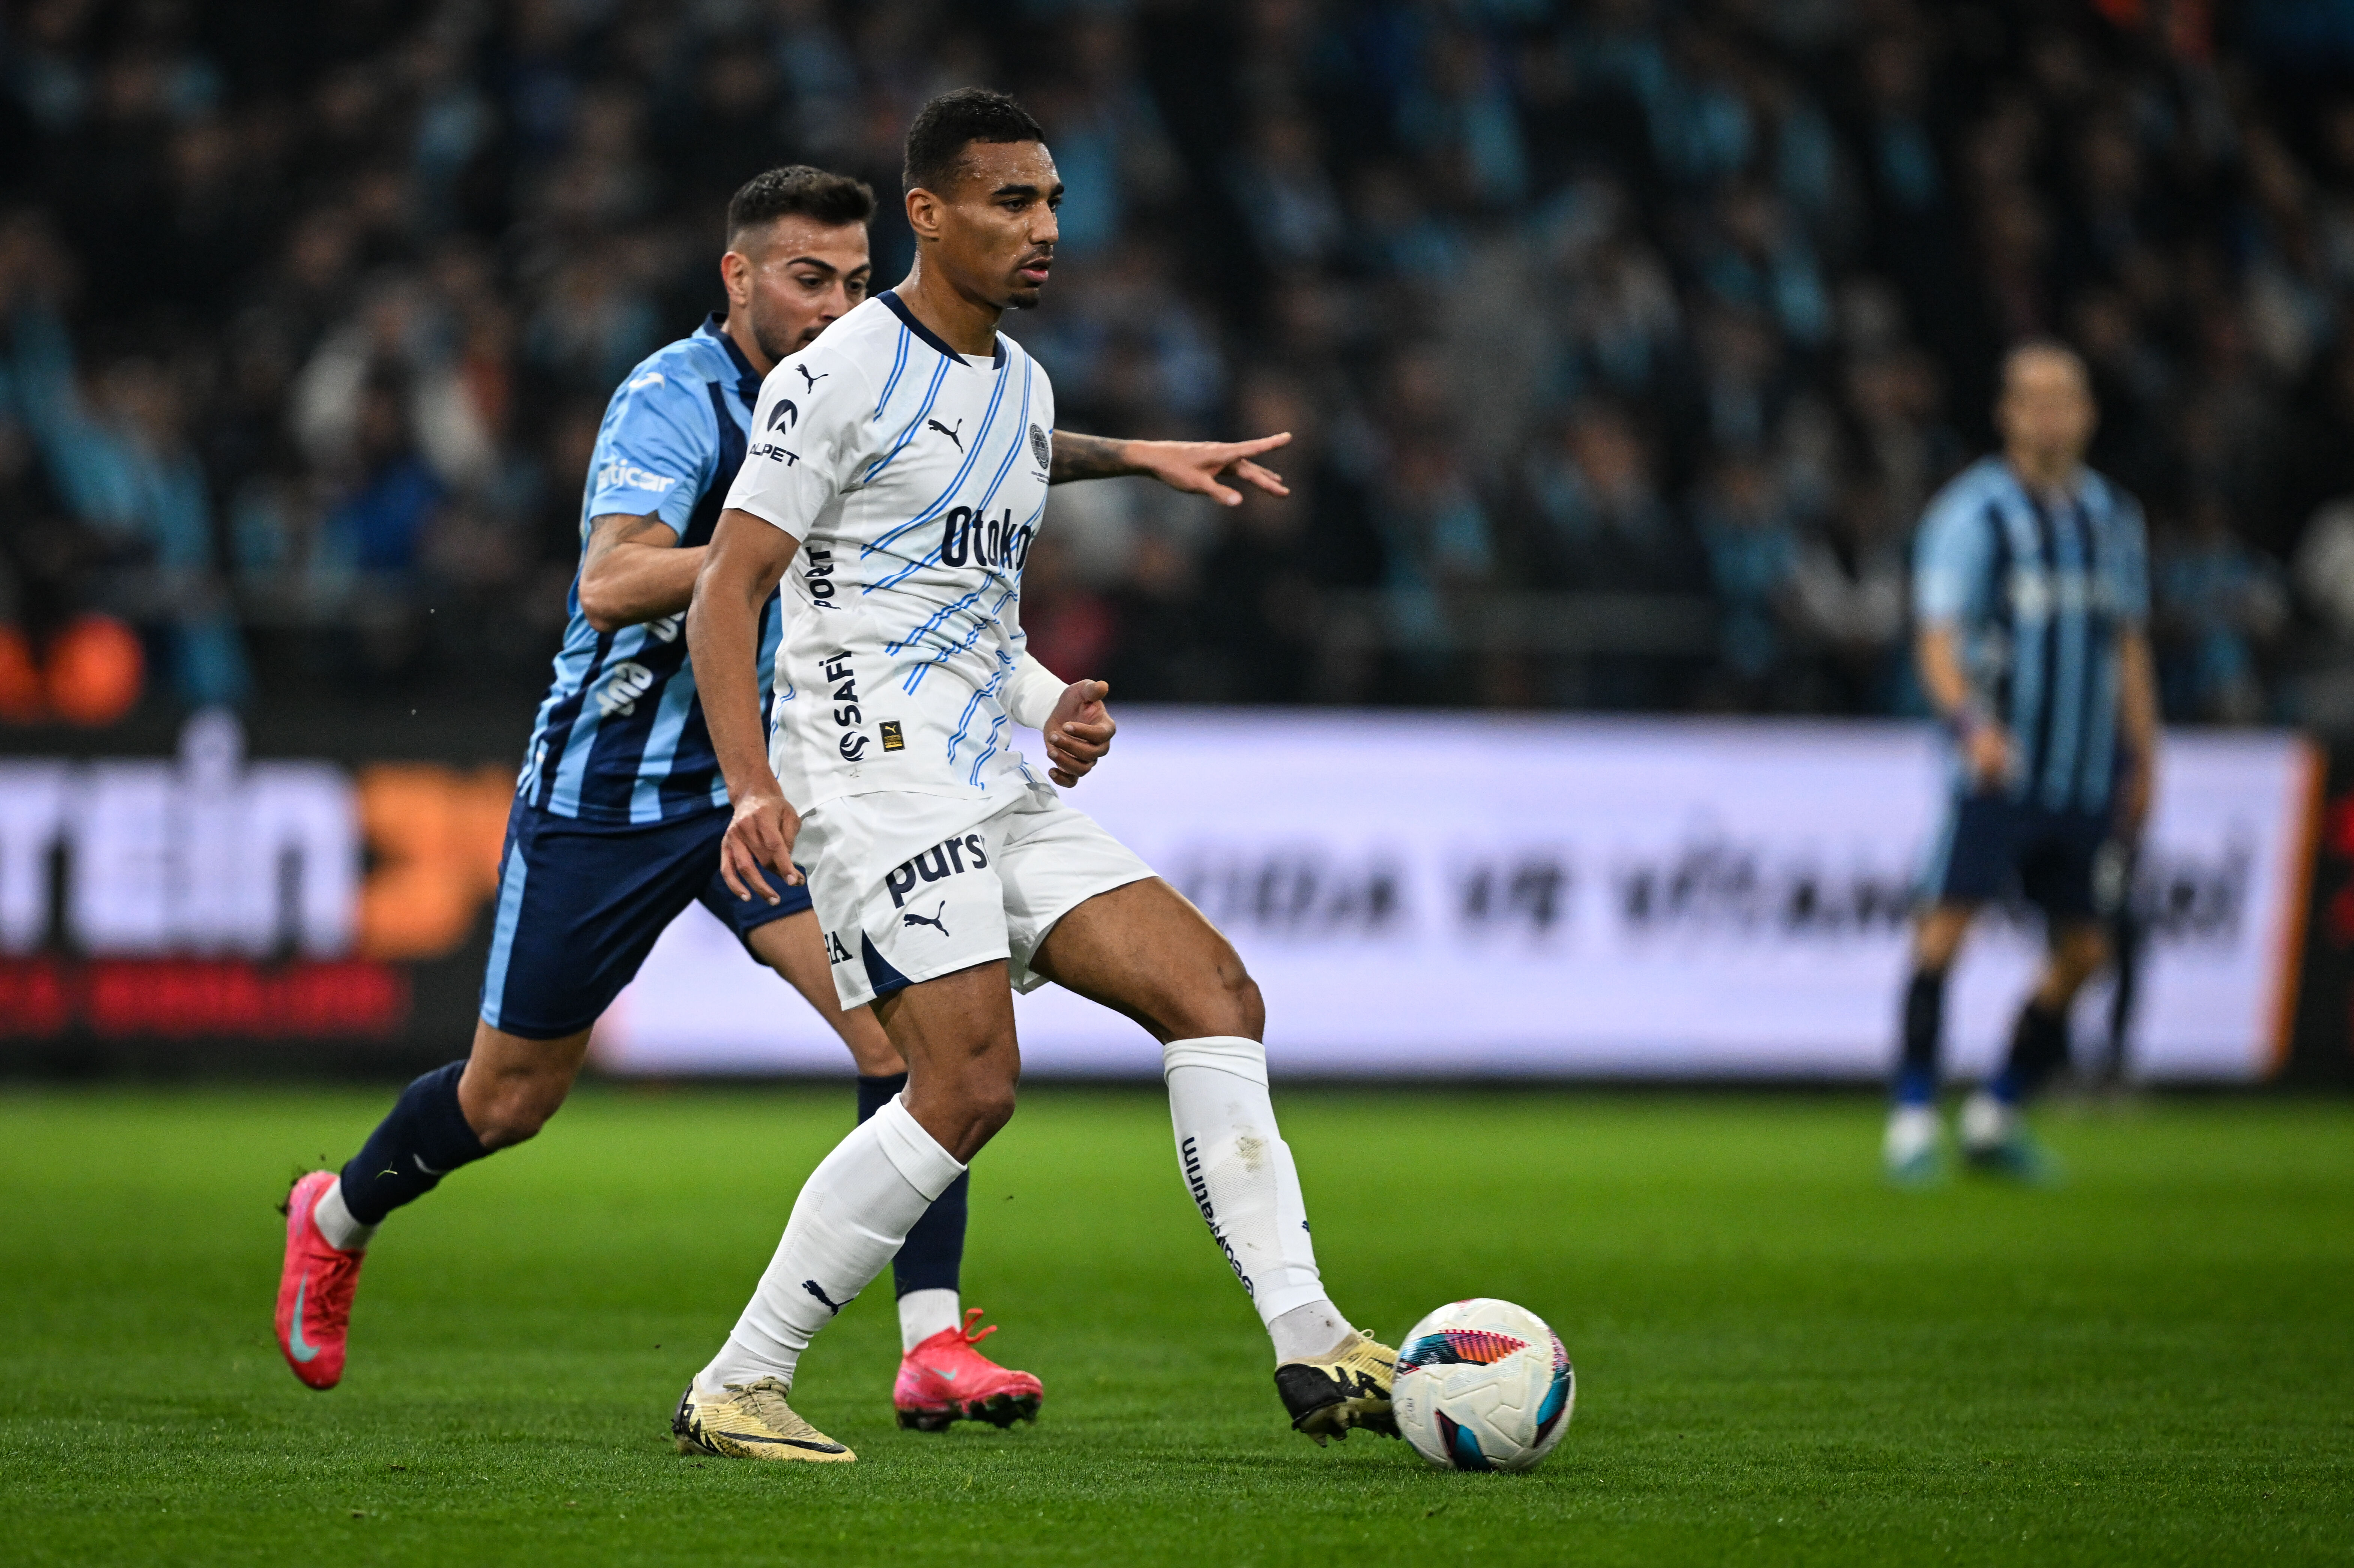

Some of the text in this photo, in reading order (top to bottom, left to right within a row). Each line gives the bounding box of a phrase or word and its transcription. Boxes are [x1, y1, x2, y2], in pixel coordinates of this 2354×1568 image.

[750, 443, 799, 467] ALPET
[941, 506, 1032, 571] Otoko
[885, 834, 988, 909] purs
